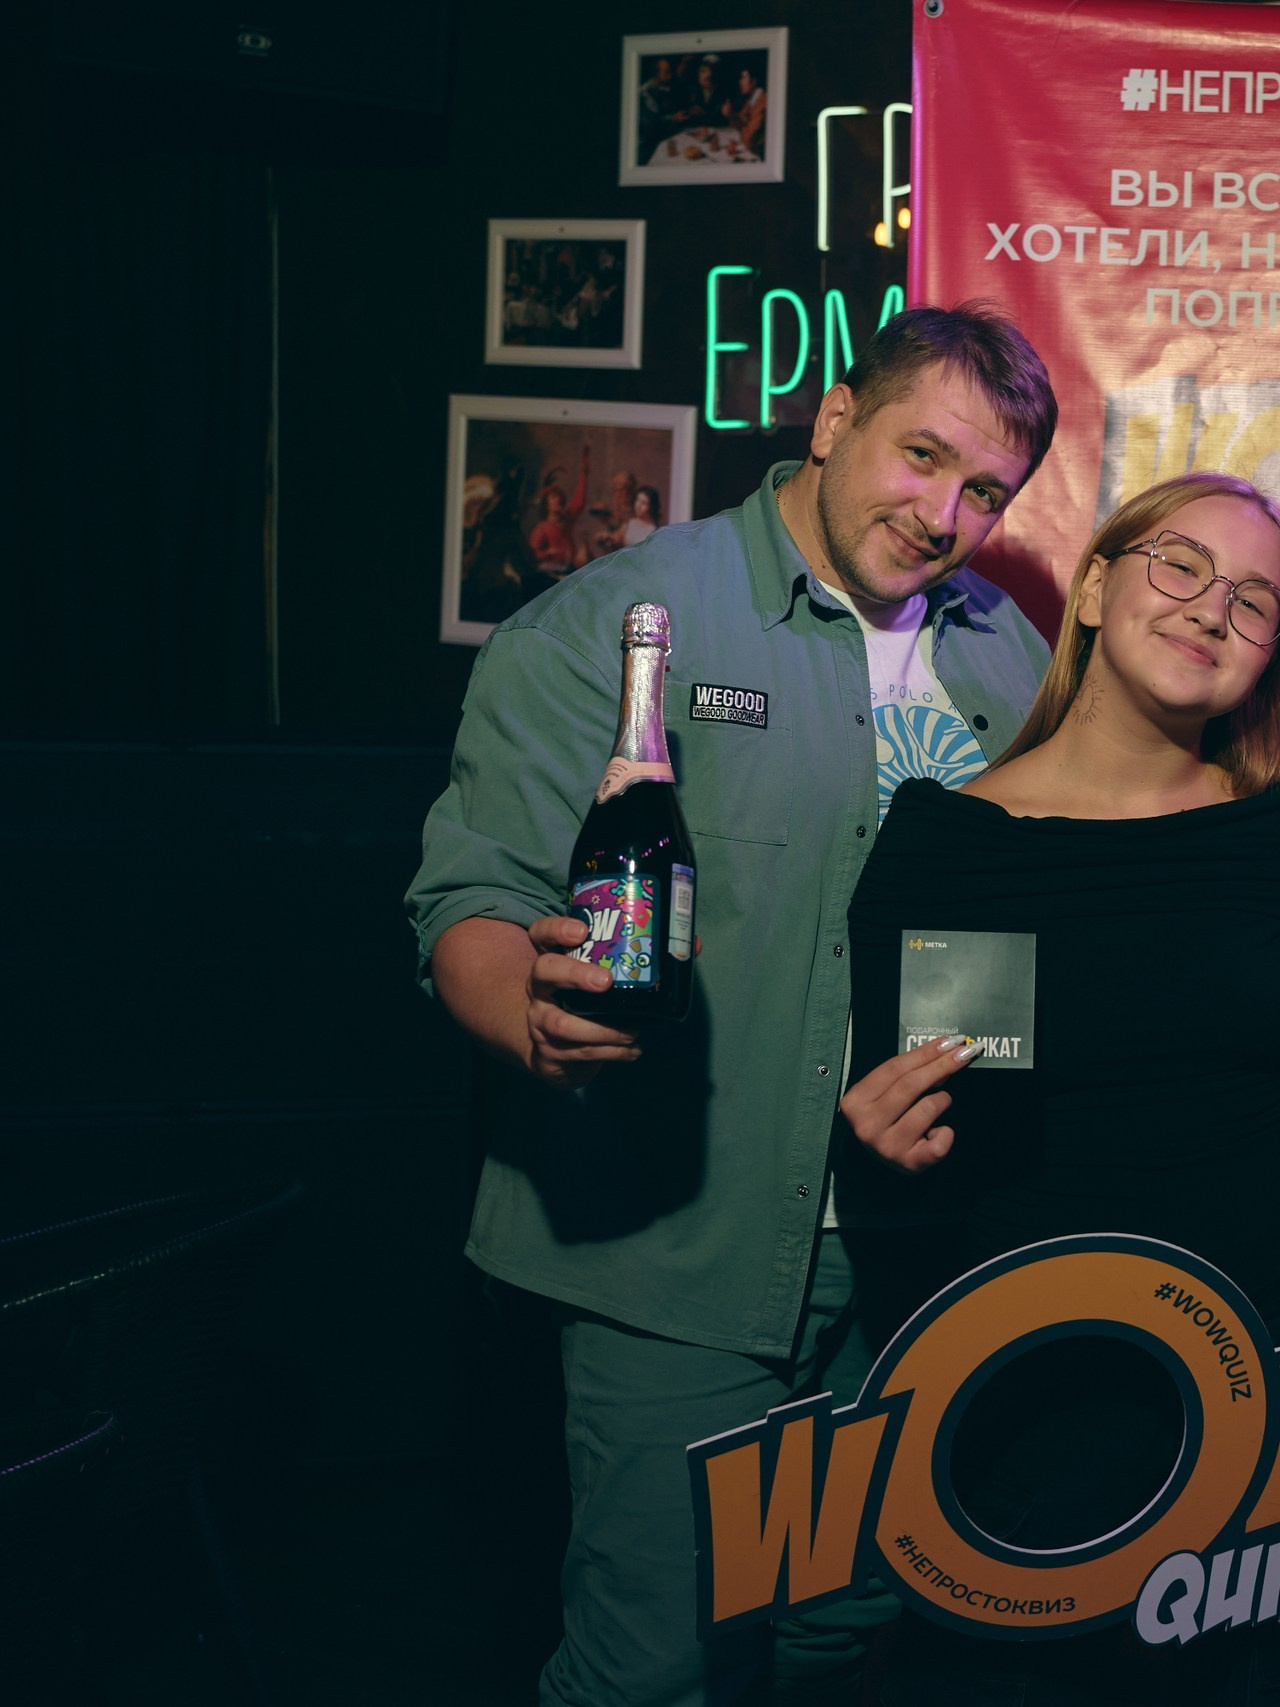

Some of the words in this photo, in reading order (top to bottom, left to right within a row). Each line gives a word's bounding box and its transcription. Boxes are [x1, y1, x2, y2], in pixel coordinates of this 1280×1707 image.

[1110, 169, 1193, 208] ВЫ
[984, 222, 1222, 273] ХОТЕЛИ,
[695, 685, 765, 712] WEGOOD
[889, 684, 933, 703] POLO
[693, 706, 726, 718] WEGOOD
[727, 709, 765, 725] GOODWEAR
[924, 941, 948, 949] МЕТКА
[906, 1026, 959, 1035] ПОДАРОЧНЫЙ
[1154, 1282, 1252, 1402] #WOWQUIZ
[893, 1534, 1077, 1615] #НЕПРОСТОКВИЗ
